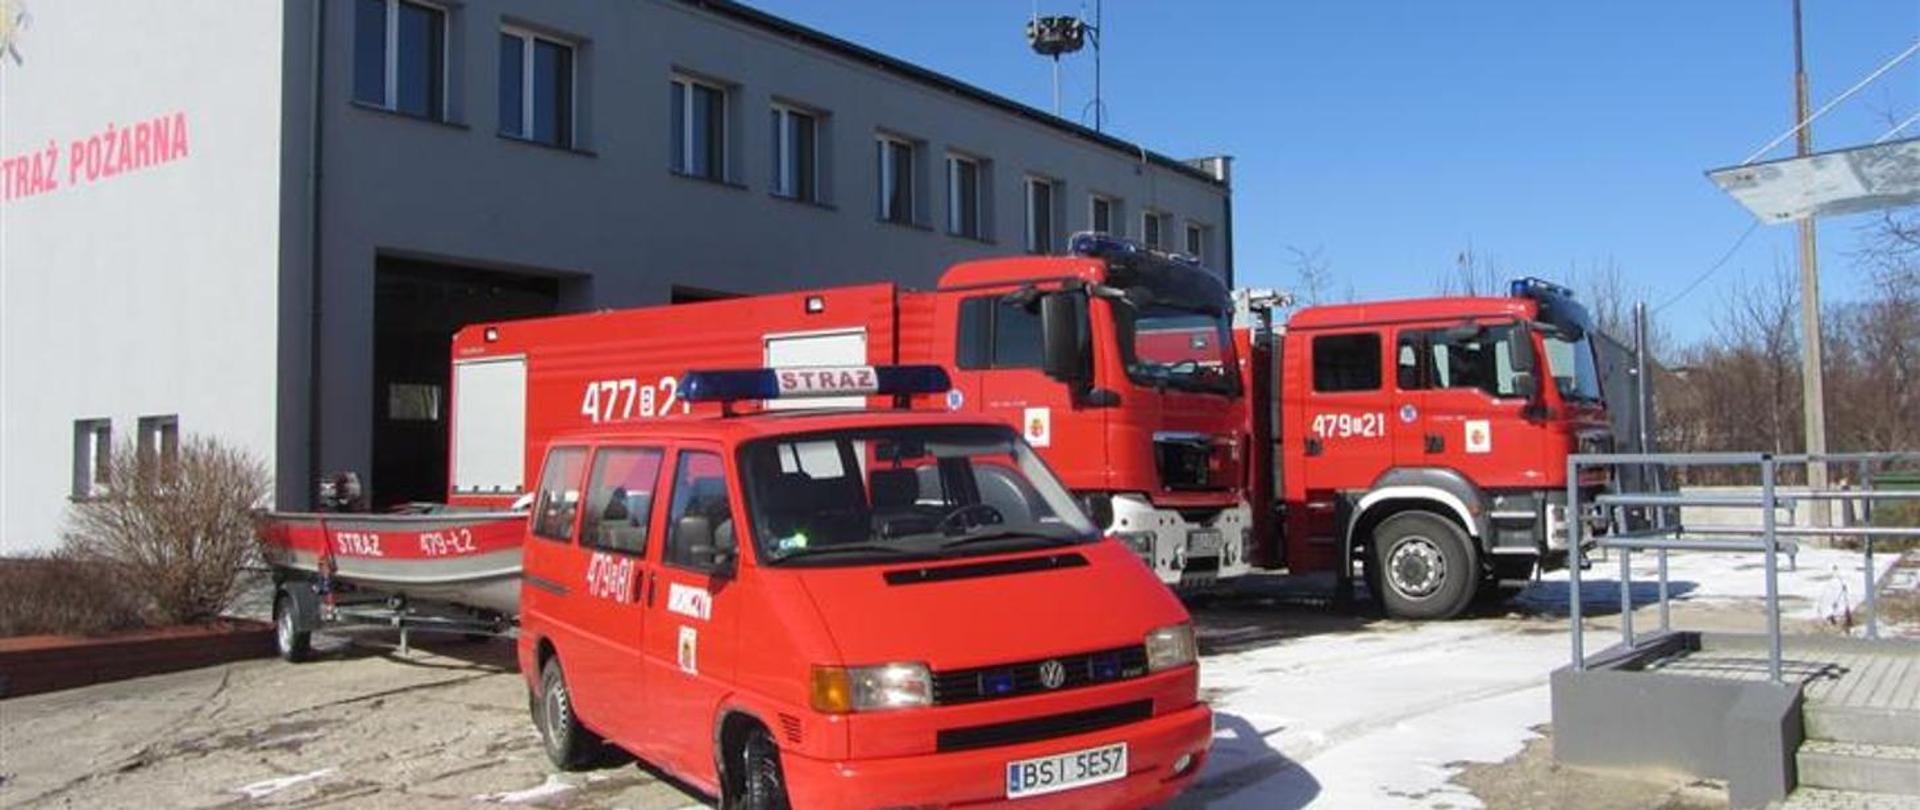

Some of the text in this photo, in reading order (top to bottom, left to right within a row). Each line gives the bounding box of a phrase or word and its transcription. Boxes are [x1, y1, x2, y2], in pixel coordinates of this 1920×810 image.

[0, 112, 188, 200] TRAŻ POŻARNA
[1023, 746, 1123, 788] BSI 5E57
